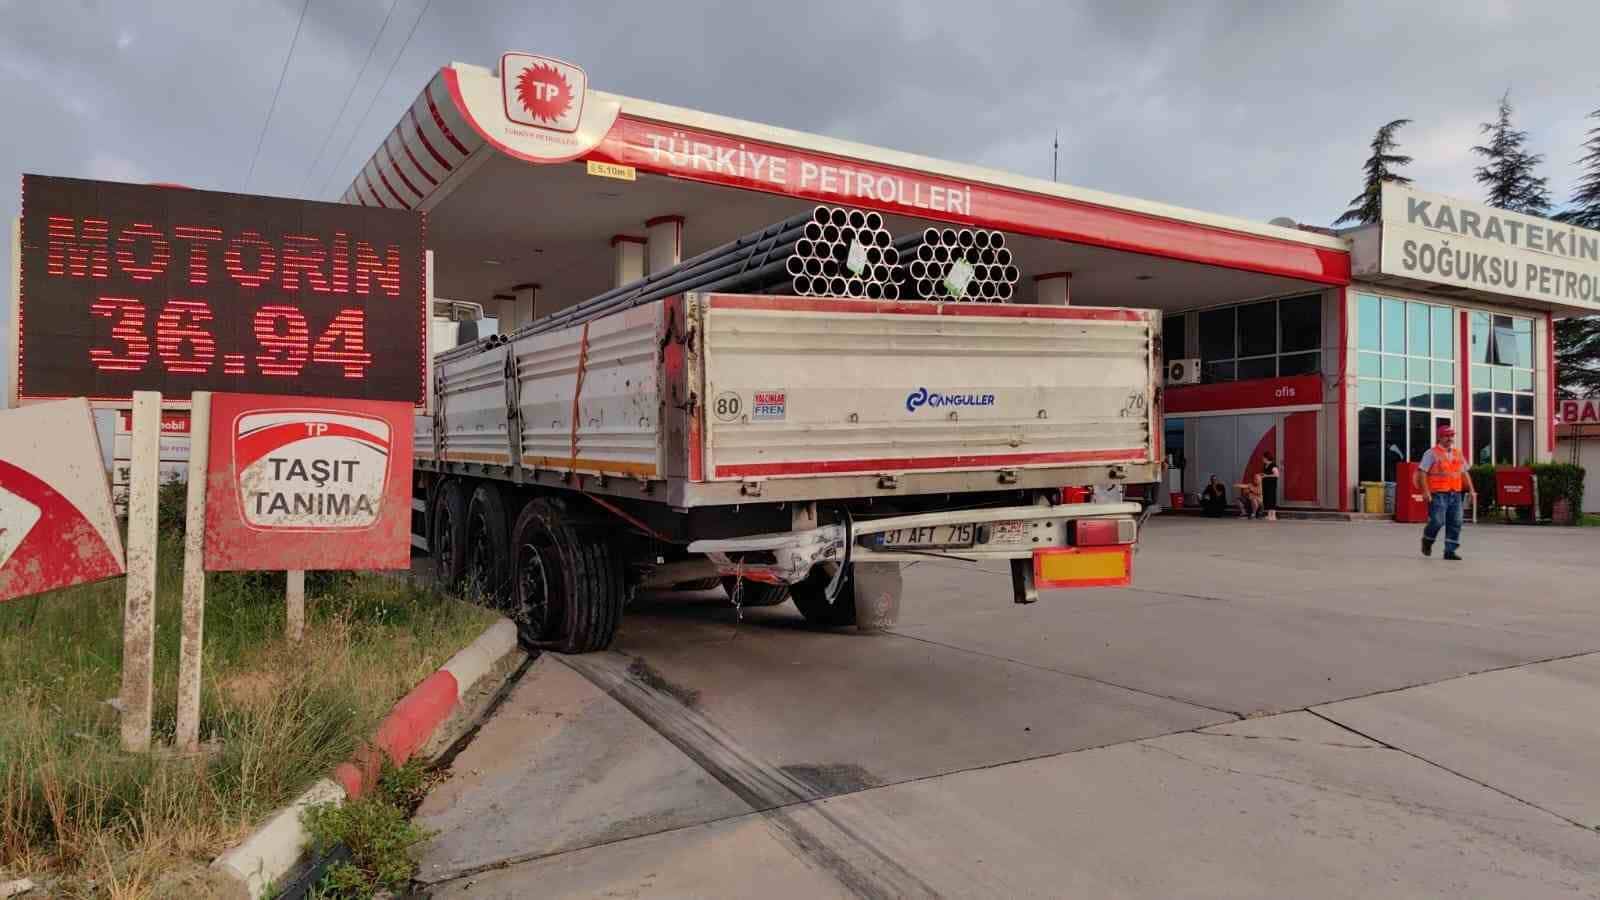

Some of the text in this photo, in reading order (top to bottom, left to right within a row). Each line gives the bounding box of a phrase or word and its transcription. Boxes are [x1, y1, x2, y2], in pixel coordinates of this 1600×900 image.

[532, 81, 559, 102] TP
[645, 131, 971, 216] TÜRKİYE PETROLLERİ
[1407, 197, 1599, 262] KARATEKİN
[48, 216, 400, 296] MOTORİN
[1402, 239, 1518, 289] SOĞUKSU
[89, 297, 372, 378] 36.94
[1128, 394, 1144, 409] 70
[1275, 386, 1296, 397] ofis
[717, 398, 739, 415] 80
[755, 405, 784, 414] FREN
[1563, 401, 1600, 423] BA
[304, 422, 329, 436] TP
[268, 457, 360, 488] TAŞIT
[254, 491, 374, 516] TANIMA
[886, 524, 971, 543] 31 AFT 715
